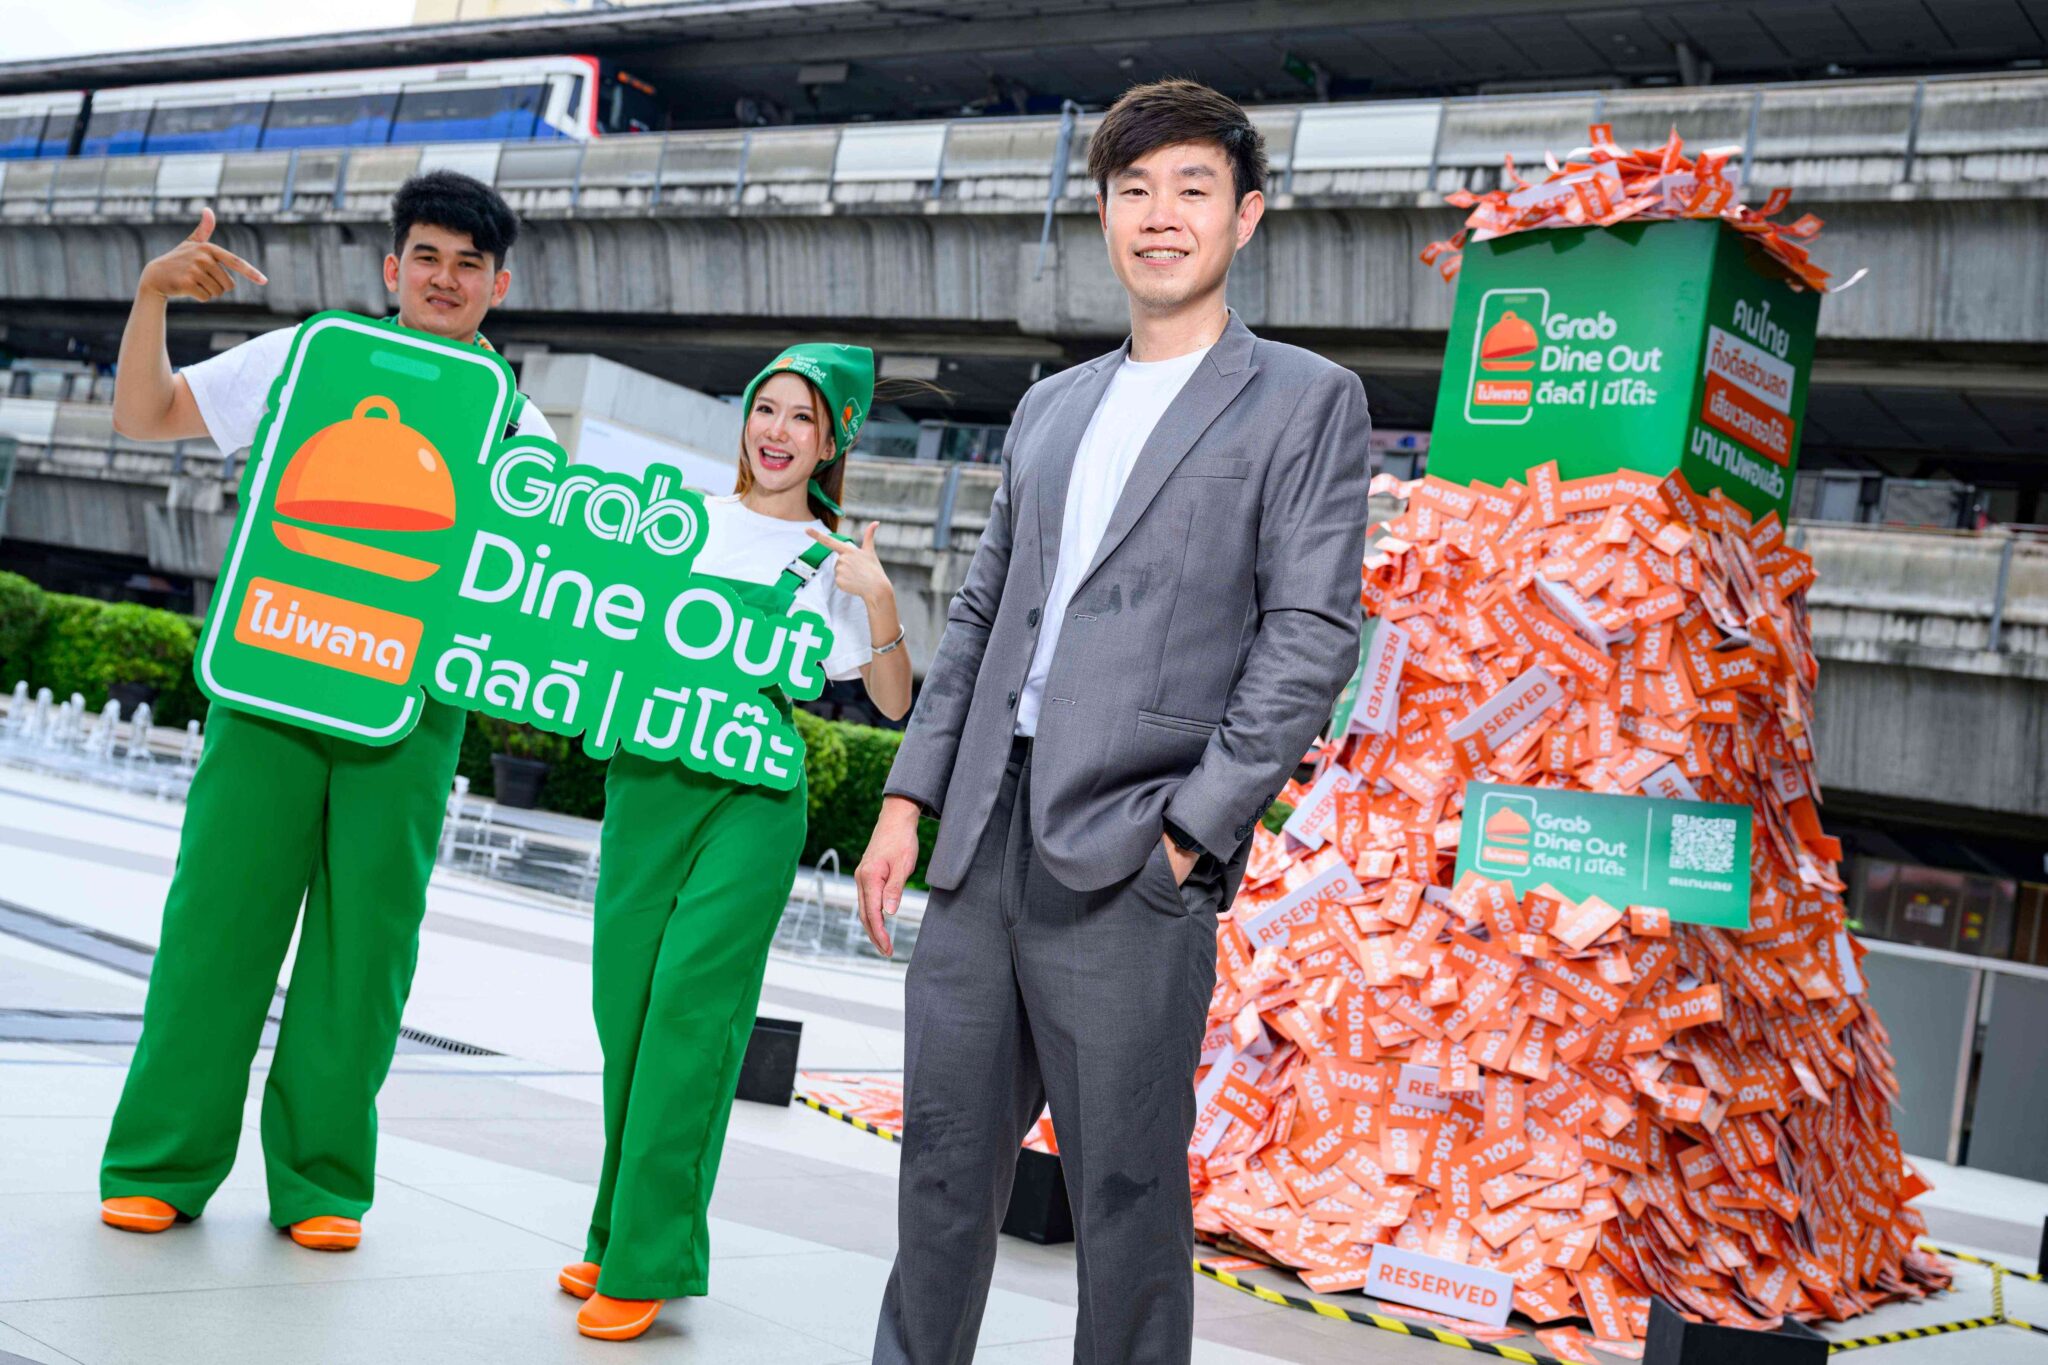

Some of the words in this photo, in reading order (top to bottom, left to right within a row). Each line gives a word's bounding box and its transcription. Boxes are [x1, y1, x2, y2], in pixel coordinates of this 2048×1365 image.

[1545, 311, 1617, 340] Grab
[1732, 298, 1789, 359] คนไทย
[1540, 345, 1602, 372] Dine
[1607, 345, 1663, 372] Out
[1477, 383, 1528, 401] ไม่พลาด
[1535, 380, 1587, 404] ดีลดี
[1602, 378, 1658, 405] มีโต๊ะ
[1691, 426, 1784, 500] มานานพอแล้ว
[490, 445, 699, 555] Grab
[459, 530, 645, 640] Dine
[664, 587, 823, 686] Out
[249, 589, 406, 670] ไม่พลาด
[1367, 631, 1400, 718] RESERVED
[1718, 657, 1756, 680] 30%
[435, 632, 588, 725] ดีลดี
[635, 685, 794, 777] มีโต๊ะ
[1535, 812, 1592, 834] Grab
[1534, 831, 1582, 852] Dine
[1585, 837, 1628, 858] Out
[1453, 944, 1477, 962] ลด
[1475, 955, 1514, 982] 25%
[1444, 1009, 1468, 1032] ลด
[1461, 979, 1497, 1014] 25%
[1557, 966, 1580, 987] ลด
[1578, 978, 1619, 1012] 30%
[1347, 994, 1364, 1031] 10%
[1658, 1005, 1681, 1019] ลด
[1682, 994, 1718, 1018] 10%
[1349, 1033, 1363, 1058] ลด
[1224, 1086, 1248, 1107] ลด
[1336, 1071, 1379, 1094] 30%
[1495, 1077, 1514, 1113] 25%
[1738, 1085, 1770, 1102] 10%
[1561, 1094, 1597, 1126] 25%
[1433, 1122, 1457, 1161] 30%
[1484, 1136, 1525, 1161] 10%
[1583, 1135, 1606, 1151] ลด
[1607, 1141, 1642, 1163] 10%
[1451, 1164, 1469, 1205] 25%
[1378, 1263, 1498, 1307] RESERVED
